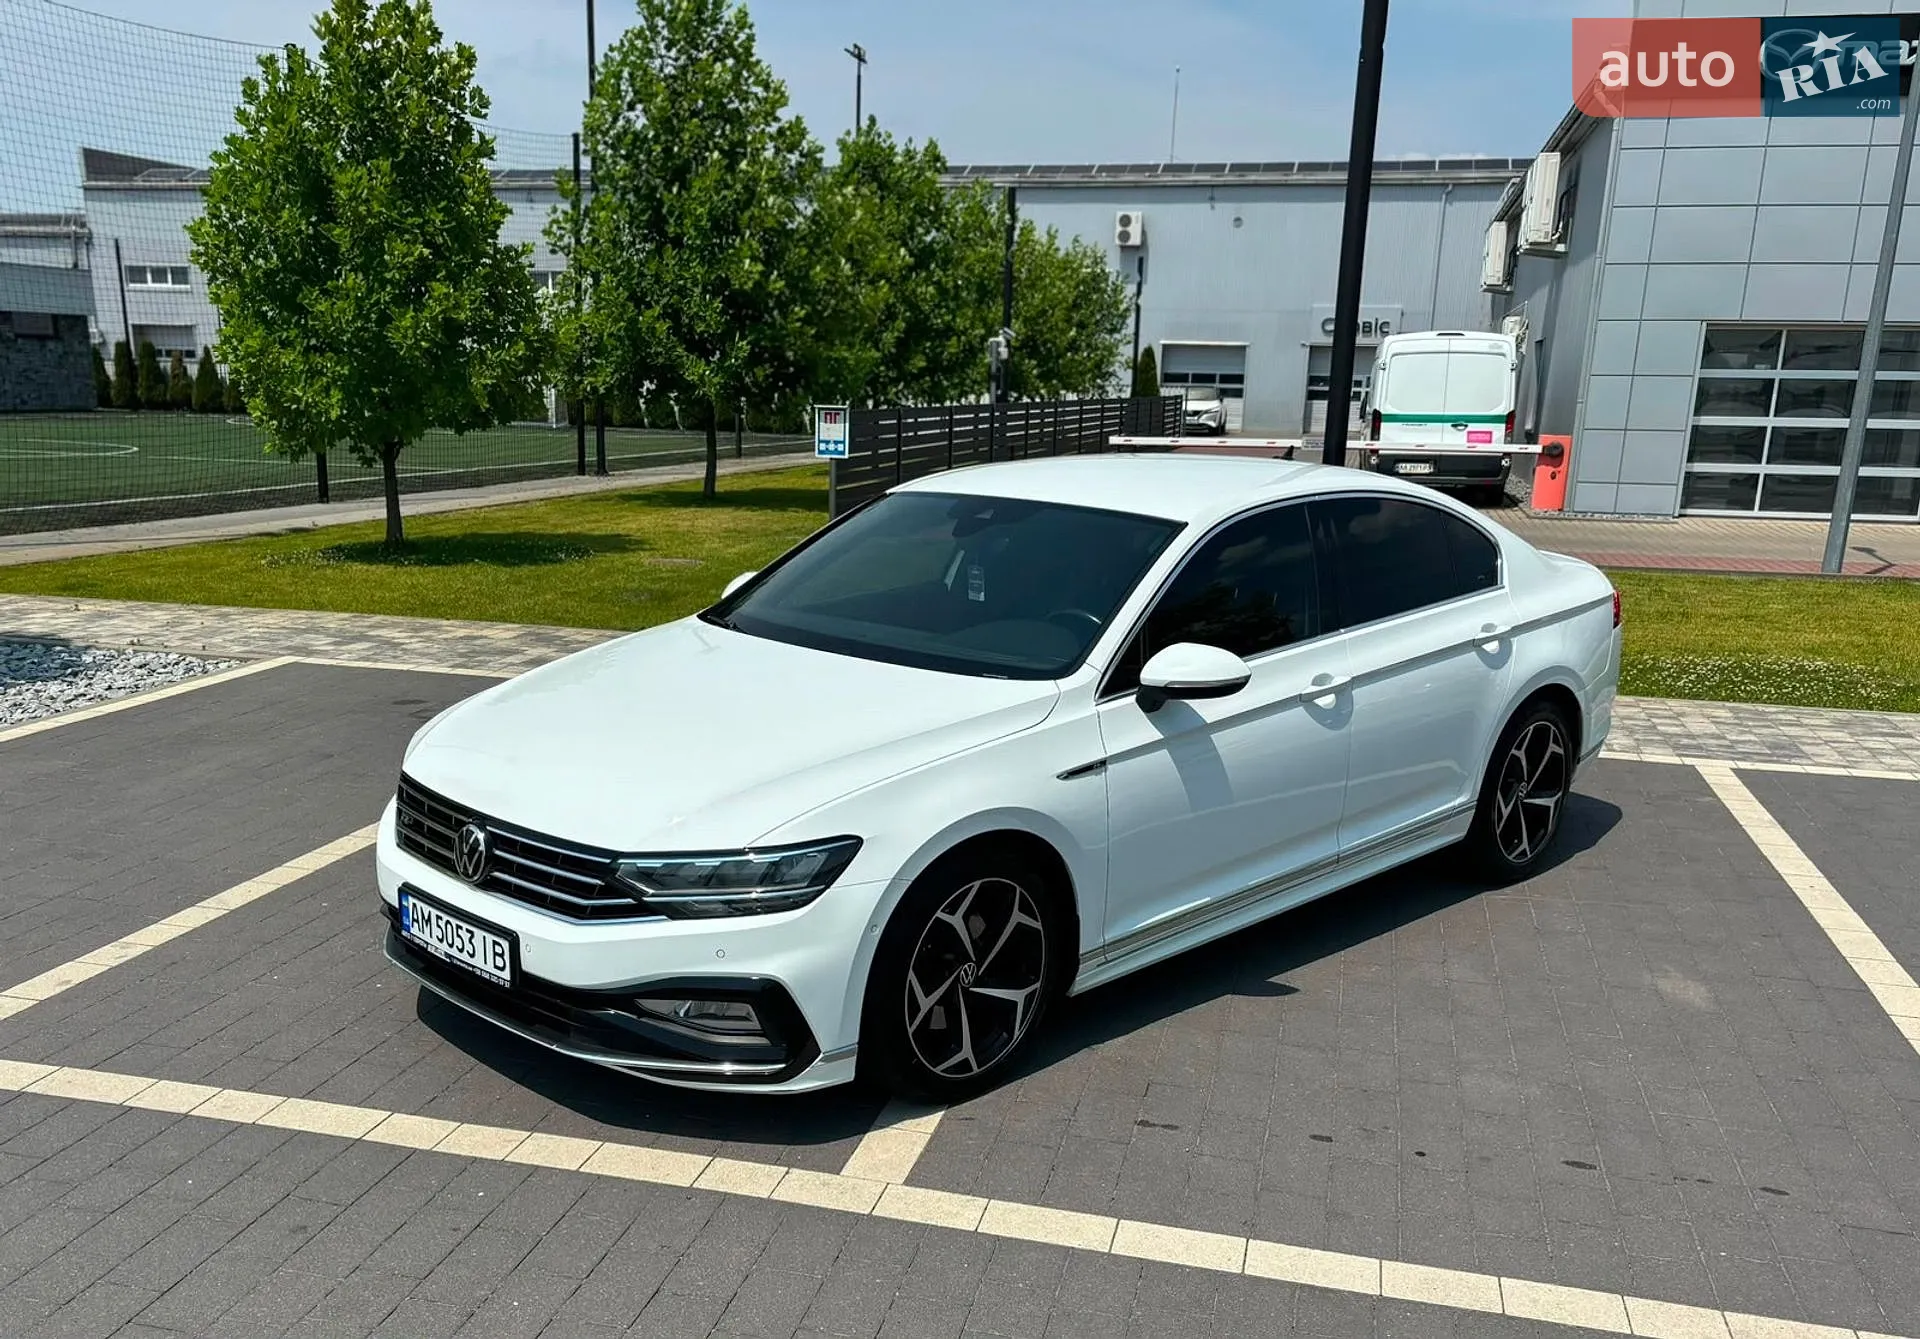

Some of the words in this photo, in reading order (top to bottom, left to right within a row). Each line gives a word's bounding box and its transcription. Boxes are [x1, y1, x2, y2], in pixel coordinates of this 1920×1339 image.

[411, 902, 433, 939] AM
[435, 914, 476, 959] 5053
[483, 935, 507, 973] IB
